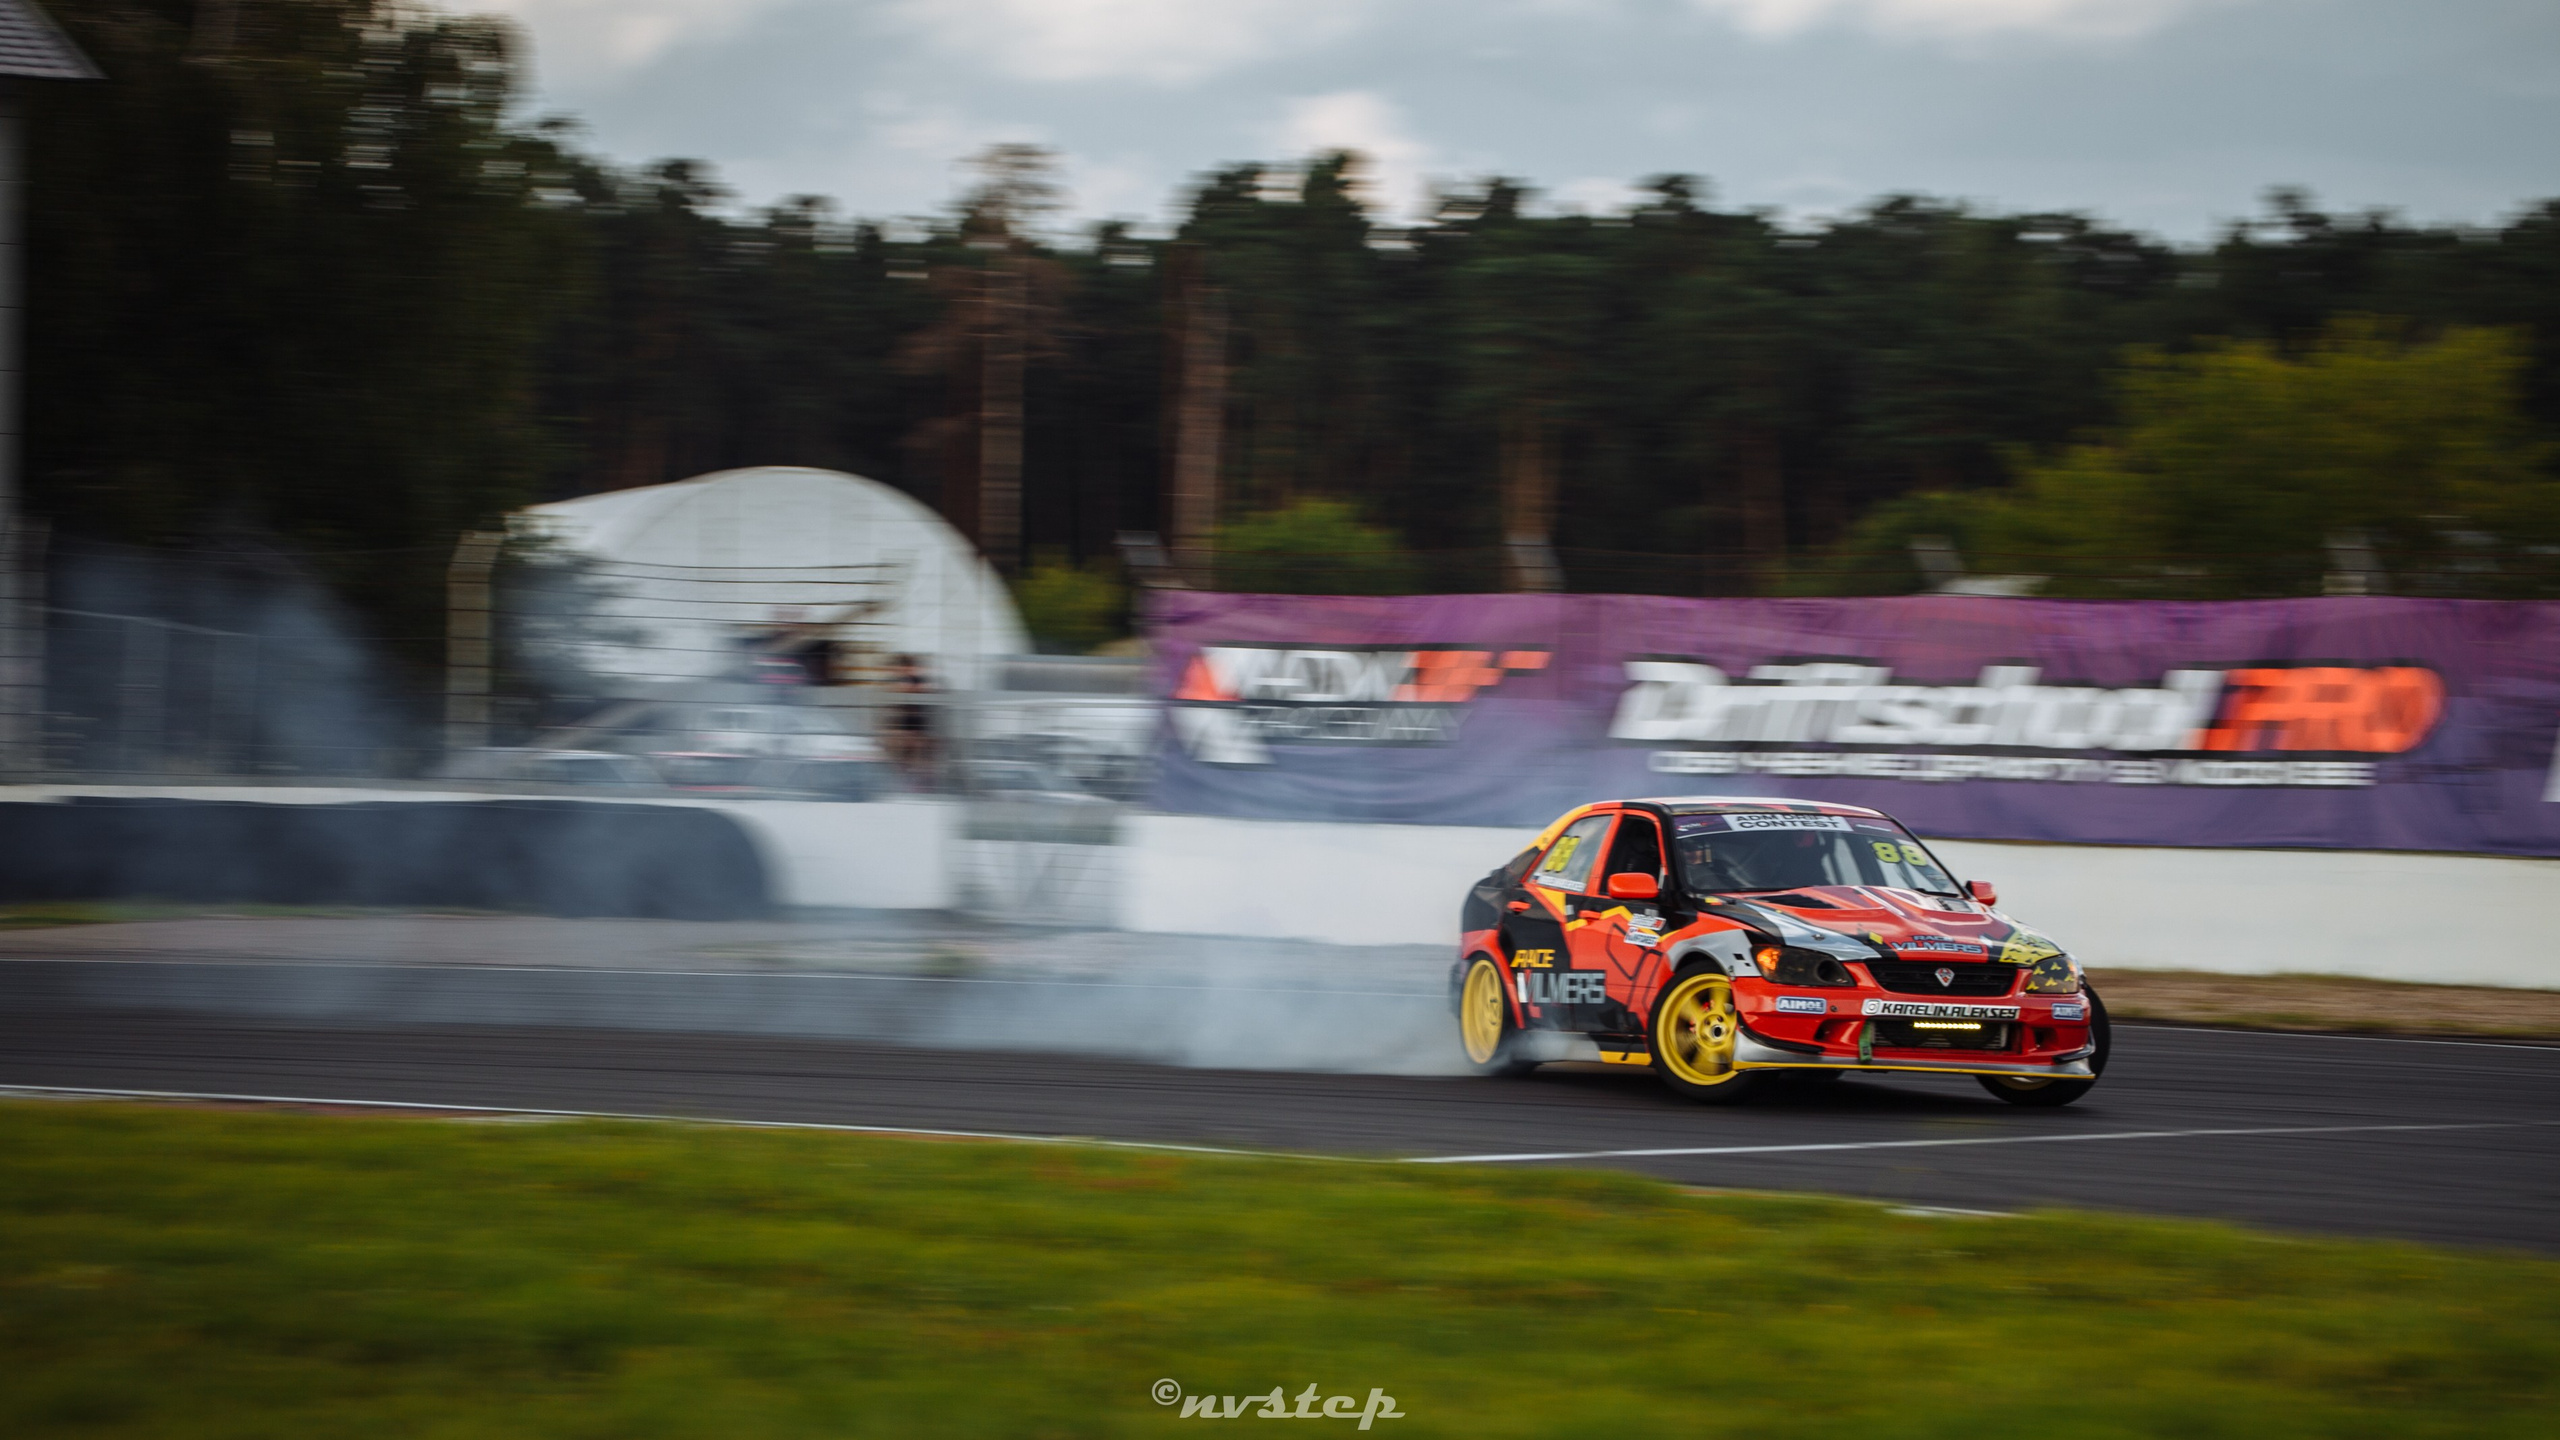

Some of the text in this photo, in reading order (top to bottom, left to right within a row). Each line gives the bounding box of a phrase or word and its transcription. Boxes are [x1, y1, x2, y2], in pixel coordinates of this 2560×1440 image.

[1740, 820, 1840, 829] CONTEST
[1871, 841, 1928, 866] 88
[1891, 942, 1982, 954] VILMERS
[1510, 949, 1555, 968] RACE
[1517, 972, 1606, 1004] VILMERS
